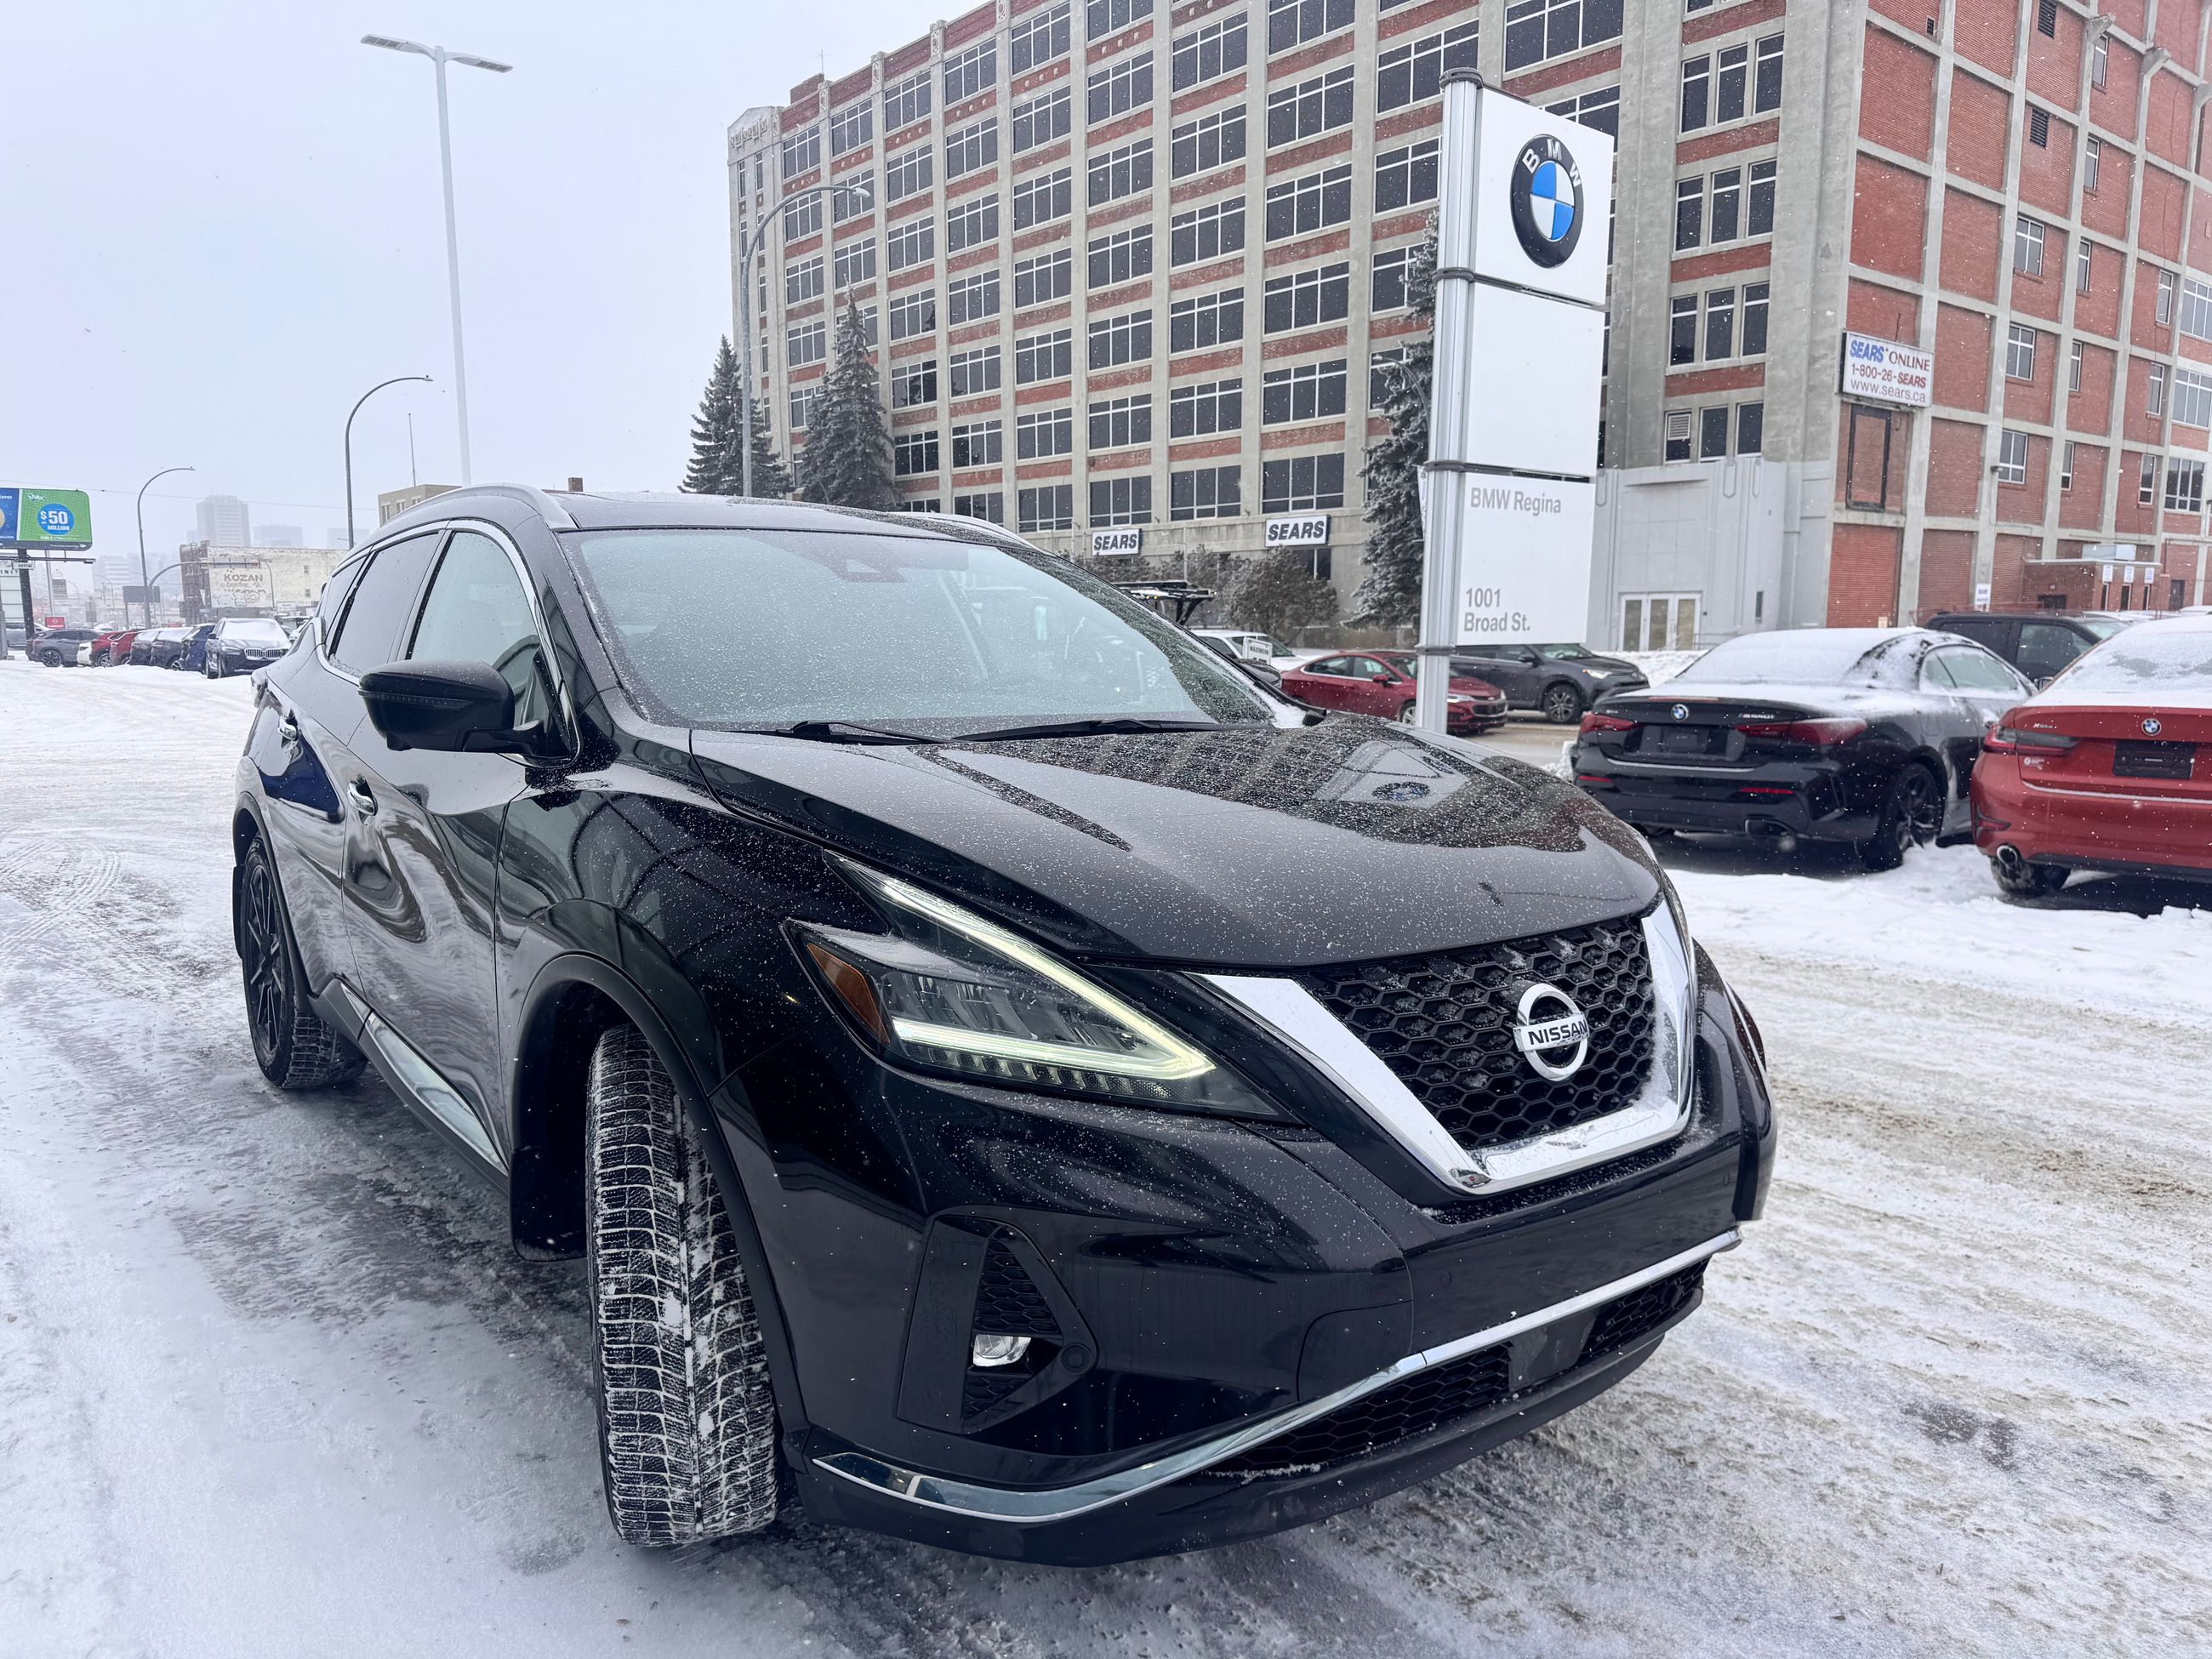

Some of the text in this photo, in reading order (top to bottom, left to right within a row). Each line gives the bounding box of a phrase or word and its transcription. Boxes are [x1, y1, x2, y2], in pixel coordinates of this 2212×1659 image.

[1522, 138, 1582, 187] BMW
[1849, 339, 1930, 372] SEARS ONLINE
[1850, 379, 1926, 403] www.sears.ca
[1469, 487, 1561, 516] BMW Regina
[1093, 533, 1137, 551] SEARS
[1266, 520, 1325, 542] SEARS
[1465, 587, 1501, 608] 1001
[1463, 611, 1531, 632] Broad St.
[1527, 1020, 1588, 1045] NISSAN
